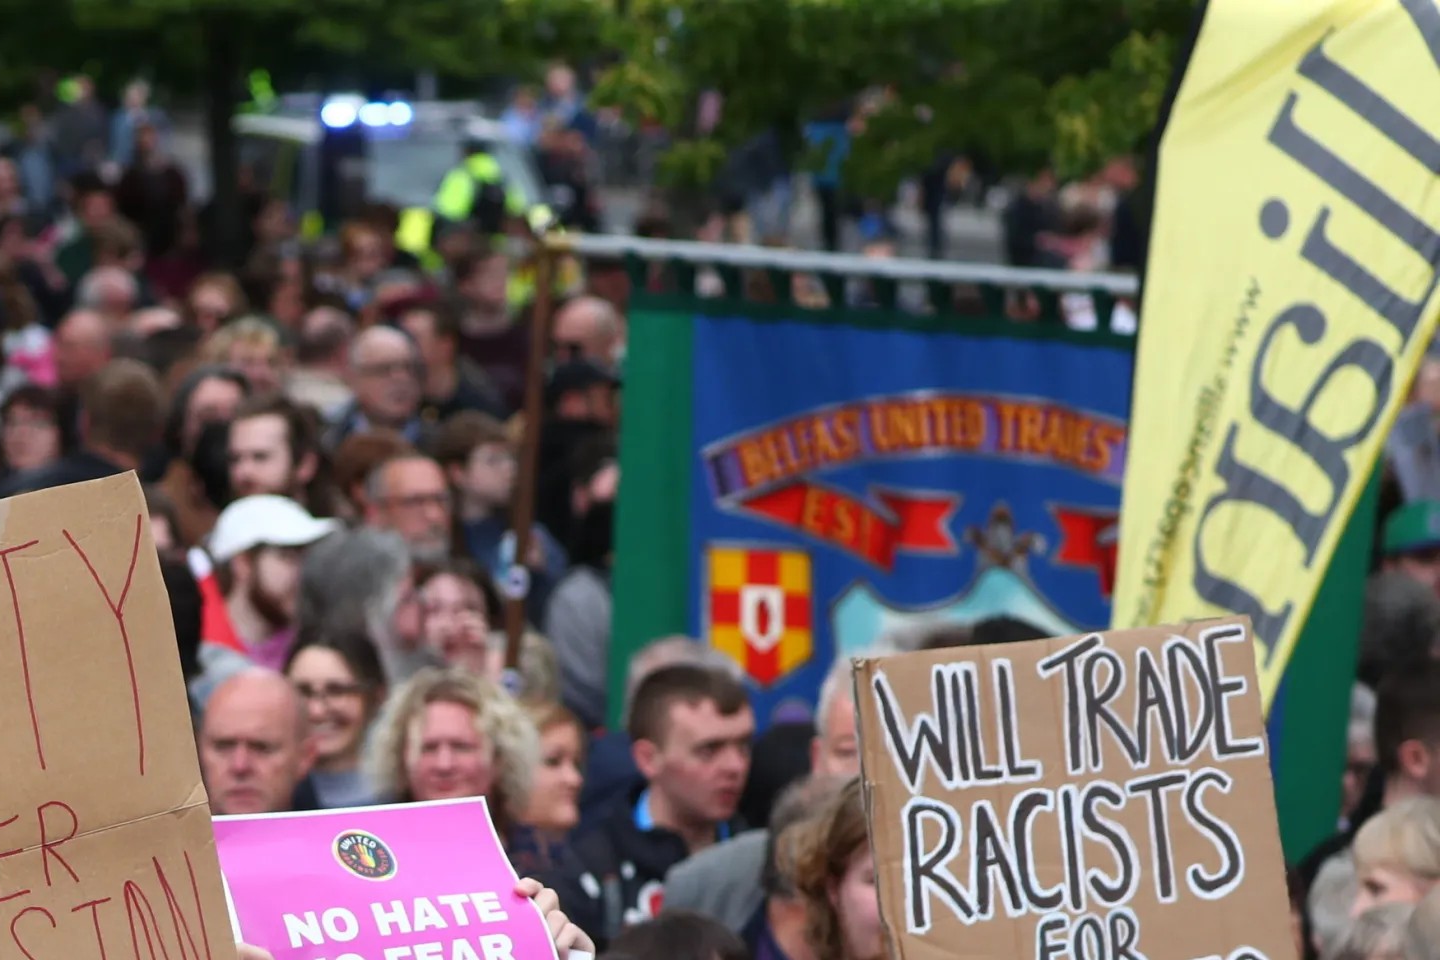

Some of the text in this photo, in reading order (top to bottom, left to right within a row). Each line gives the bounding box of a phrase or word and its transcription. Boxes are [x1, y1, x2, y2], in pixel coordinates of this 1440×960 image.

[872, 399, 987, 452] UNITED
[873, 624, 1263, 794] WILL TRADE
[340, 836, 376, 850] UNITED
[902, 767, 1244, 933] RACISTS
[282, 890, 509, 949] NO HATE
